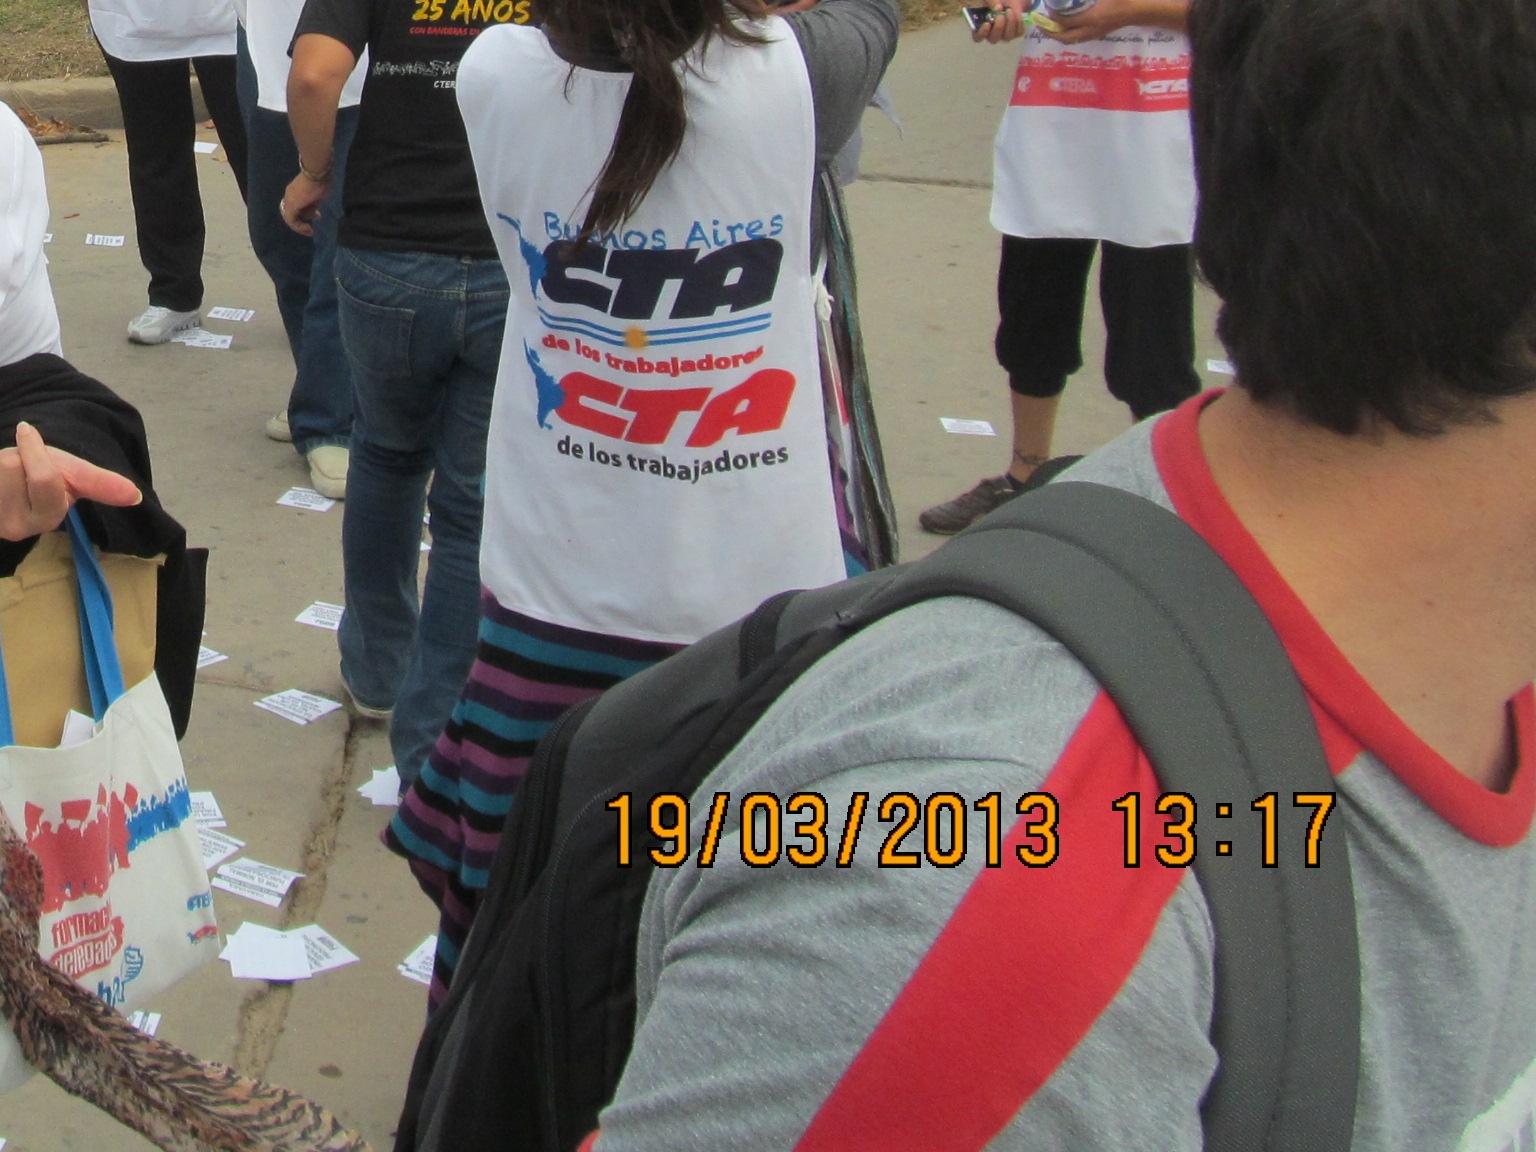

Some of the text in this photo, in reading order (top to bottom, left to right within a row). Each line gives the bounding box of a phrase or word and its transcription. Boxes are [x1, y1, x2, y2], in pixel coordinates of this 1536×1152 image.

[409, 26, 425, 35] CON
[426, 26, 468, 36] BANDERAS
[433, 80, 456, 89] CTER
[685, 214, 784, 250] Aires
[541, 238, 784, 320] CTA
[541, 334, 765, 378] de los trabajadores
[555, 368, 797, 449] CTA
[557, 435, 789, 485] de los trabajadores
